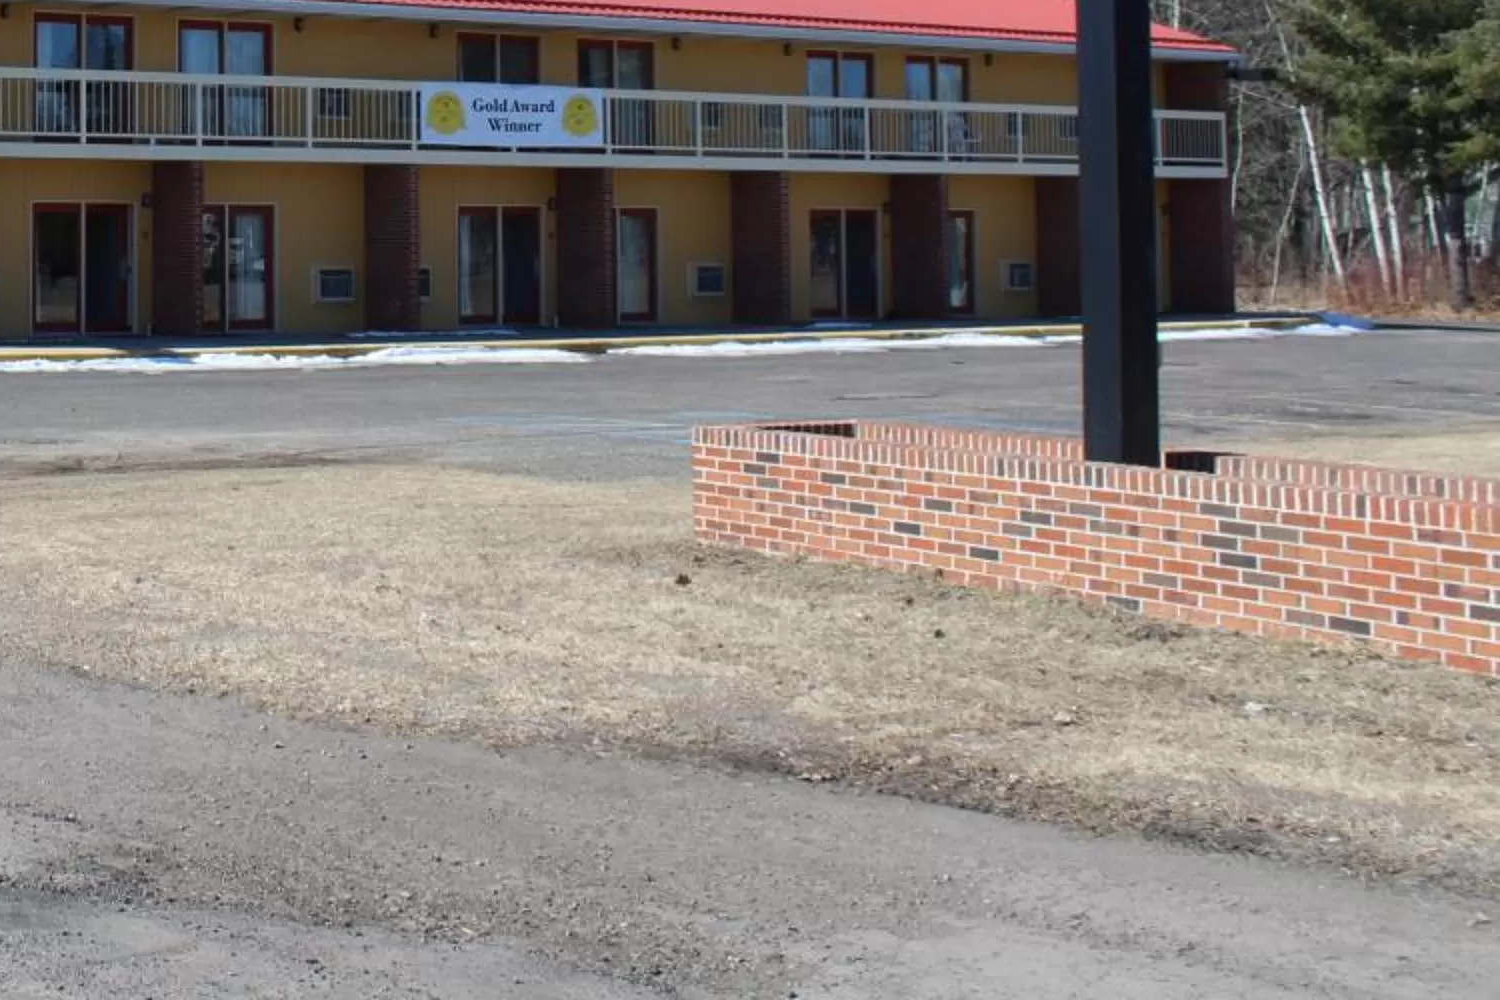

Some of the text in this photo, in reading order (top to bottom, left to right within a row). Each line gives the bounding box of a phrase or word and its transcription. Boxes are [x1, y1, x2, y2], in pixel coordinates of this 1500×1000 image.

[472, 98, 555, 113] Gold Award
[487, 117, 542, 132] Winner
